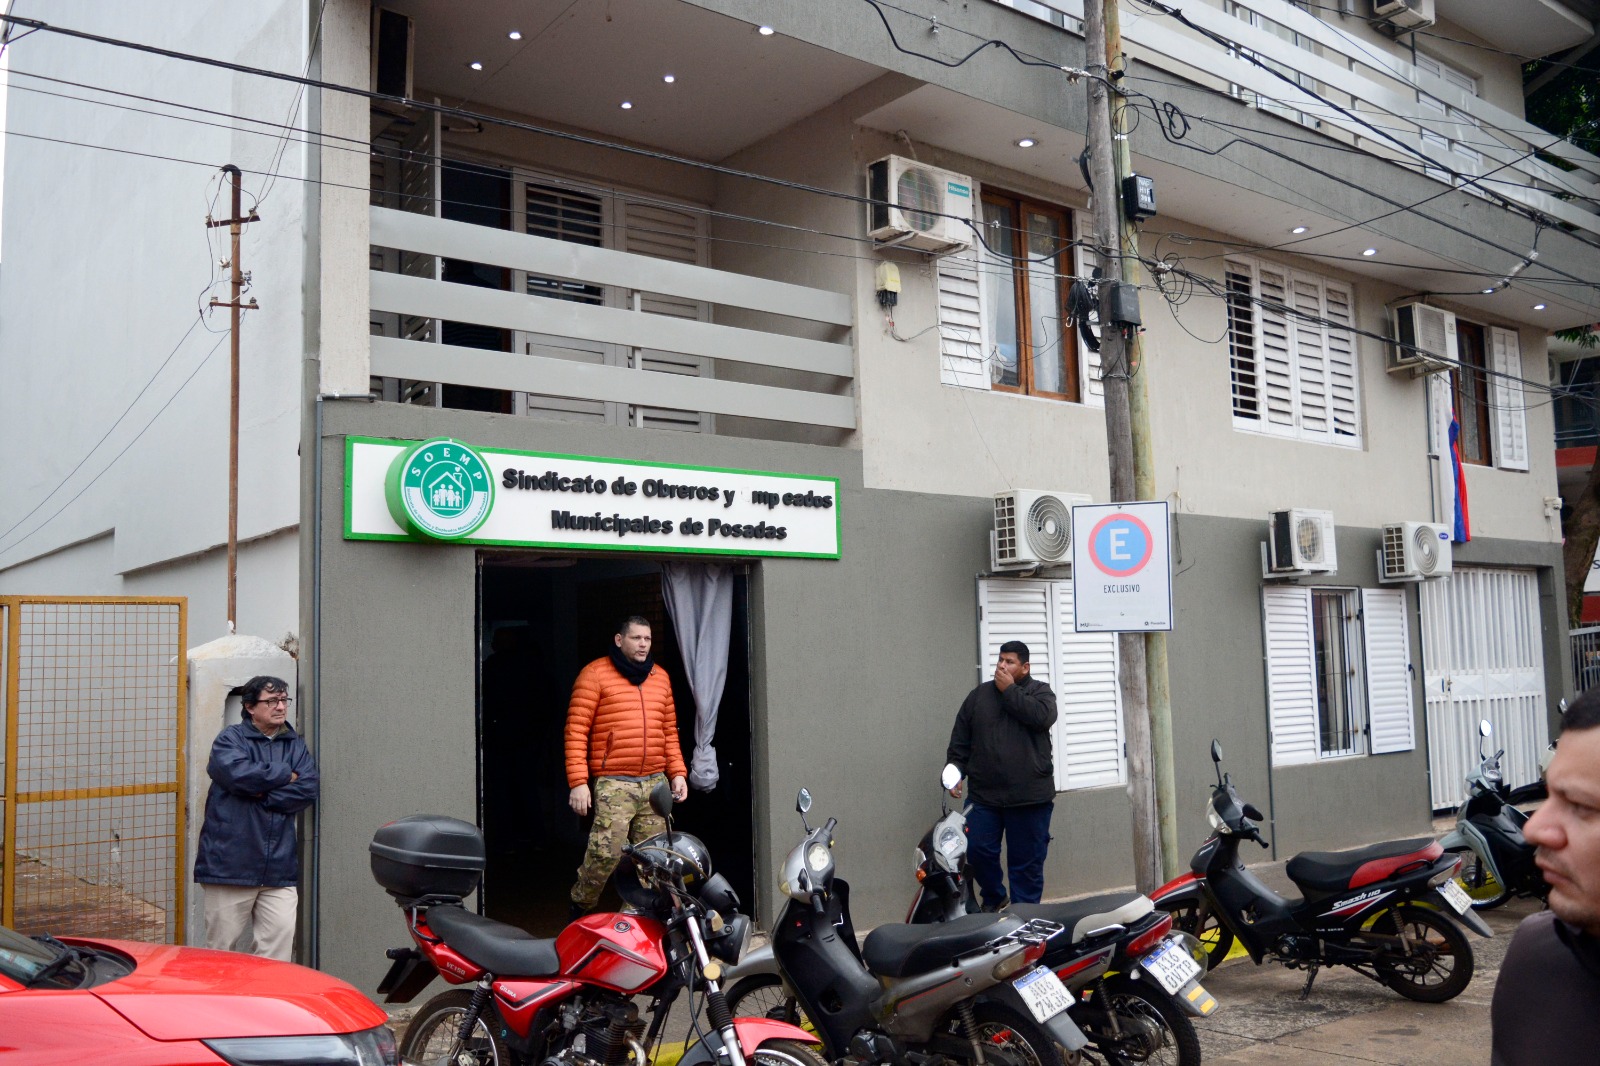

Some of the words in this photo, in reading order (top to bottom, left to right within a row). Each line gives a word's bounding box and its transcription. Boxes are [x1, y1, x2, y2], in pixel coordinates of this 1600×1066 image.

[411, 447, 483, 480] SOEMP
[502, 468, 607, 495] Sindicato
[611, 476, 637, 496] de
[642, 479, 719, 501] Obreros
[723, 489, 735, 508] y
[551, 510, 673, 537] Municipales
[679, 517, 704, 535] de
[708, 518, 787, 540] Posadas
[1109, 527, 1131, 561] E
[1103, 584, 1140, 594] EXCLUSIVO
